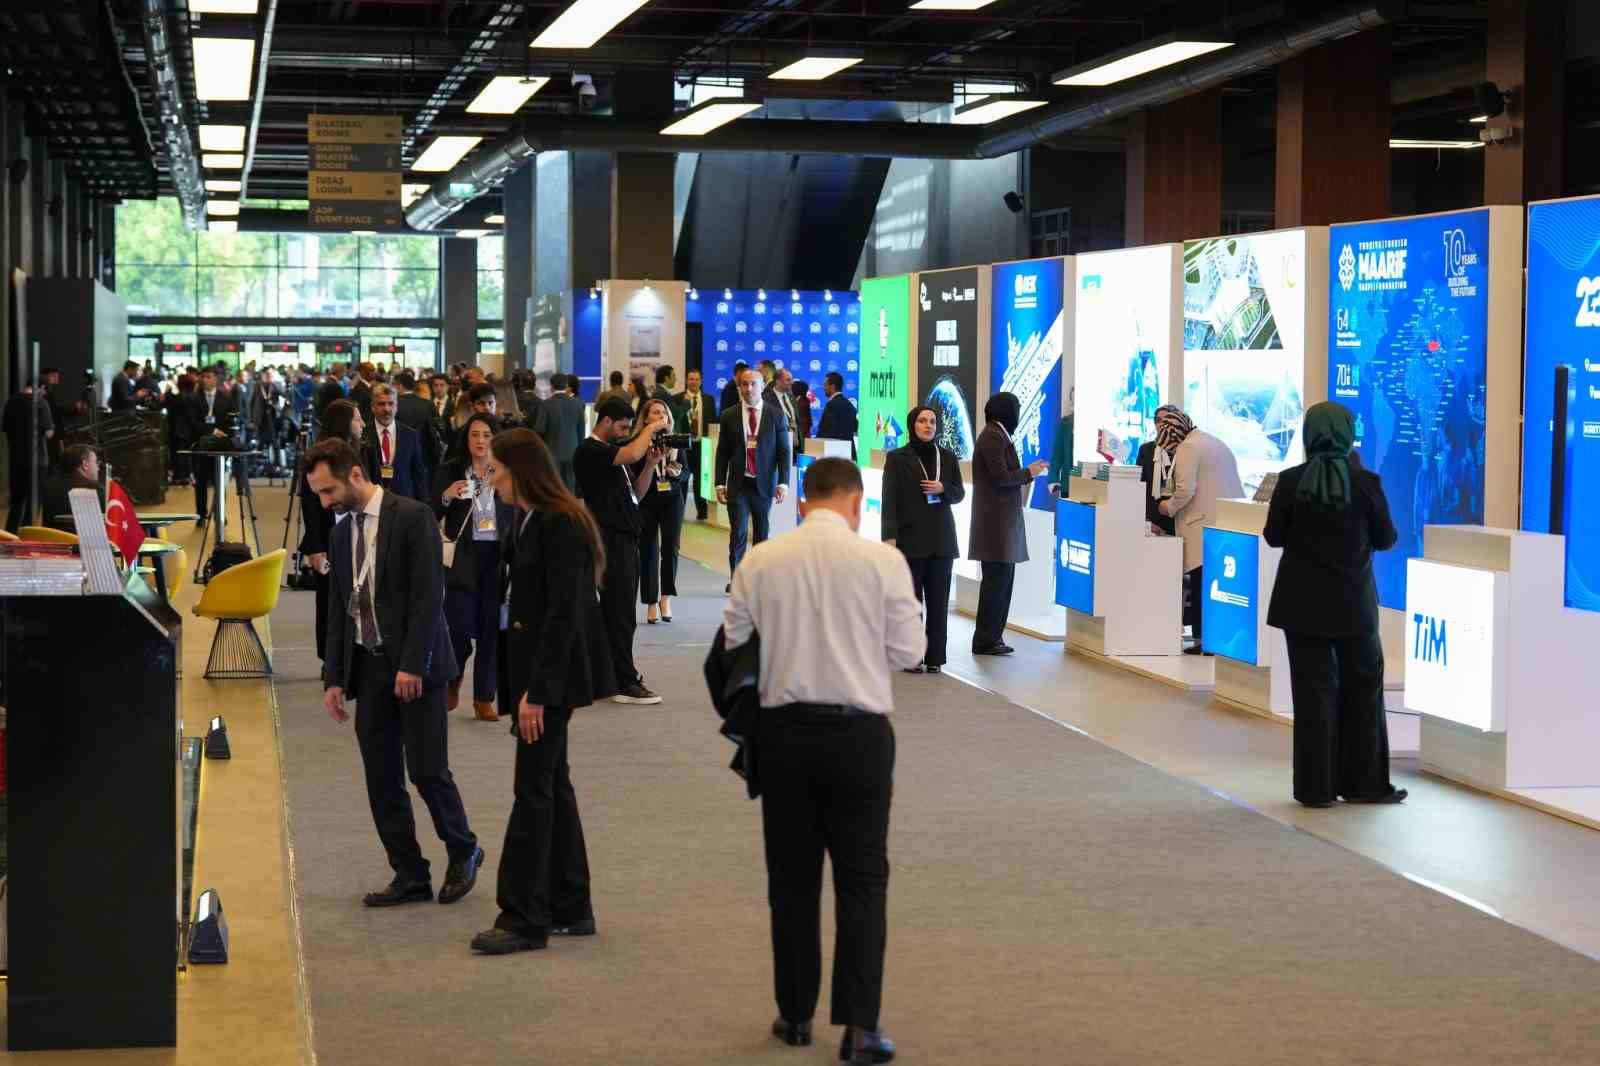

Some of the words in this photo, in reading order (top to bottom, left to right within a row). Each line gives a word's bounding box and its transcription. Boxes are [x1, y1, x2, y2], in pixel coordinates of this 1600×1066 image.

[315, 129, 350, 137] ROOMS
[315, 152, 360, 161] BILATERAL
[315, 162, 348, 170] ROOMS
[315, 215, 343, 224] EVENT
[344, 215, 372, 224] SPACE
[1443, 229, 1466, 277] 10
[1336, 308, 1349, 331] 64
